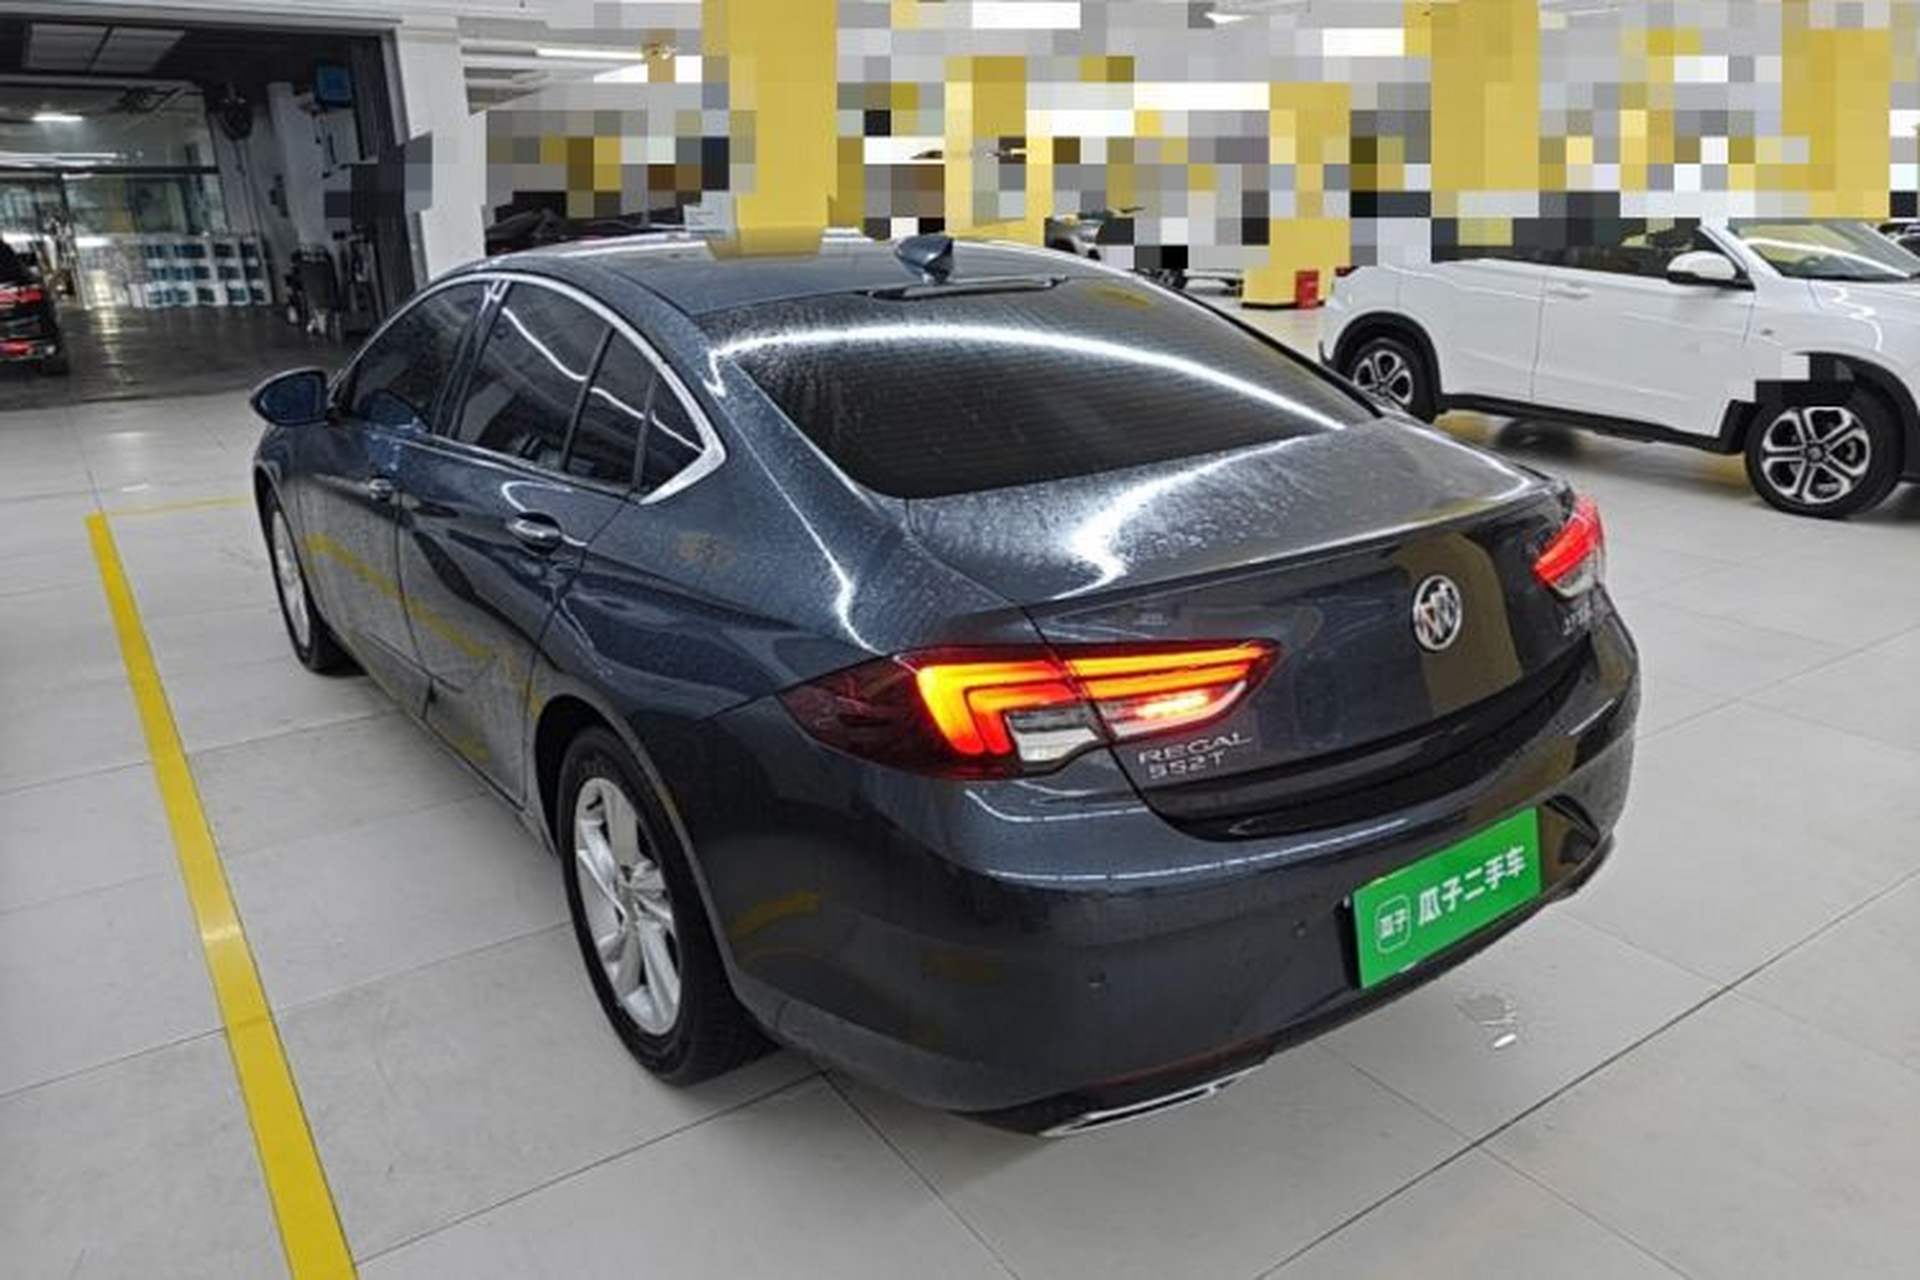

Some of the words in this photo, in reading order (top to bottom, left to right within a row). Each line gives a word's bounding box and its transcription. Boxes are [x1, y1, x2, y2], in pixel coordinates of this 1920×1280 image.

[1138, 732, 1252, 764] REGAL
[1418, 845, 1526, 926] 瓜子二手车
